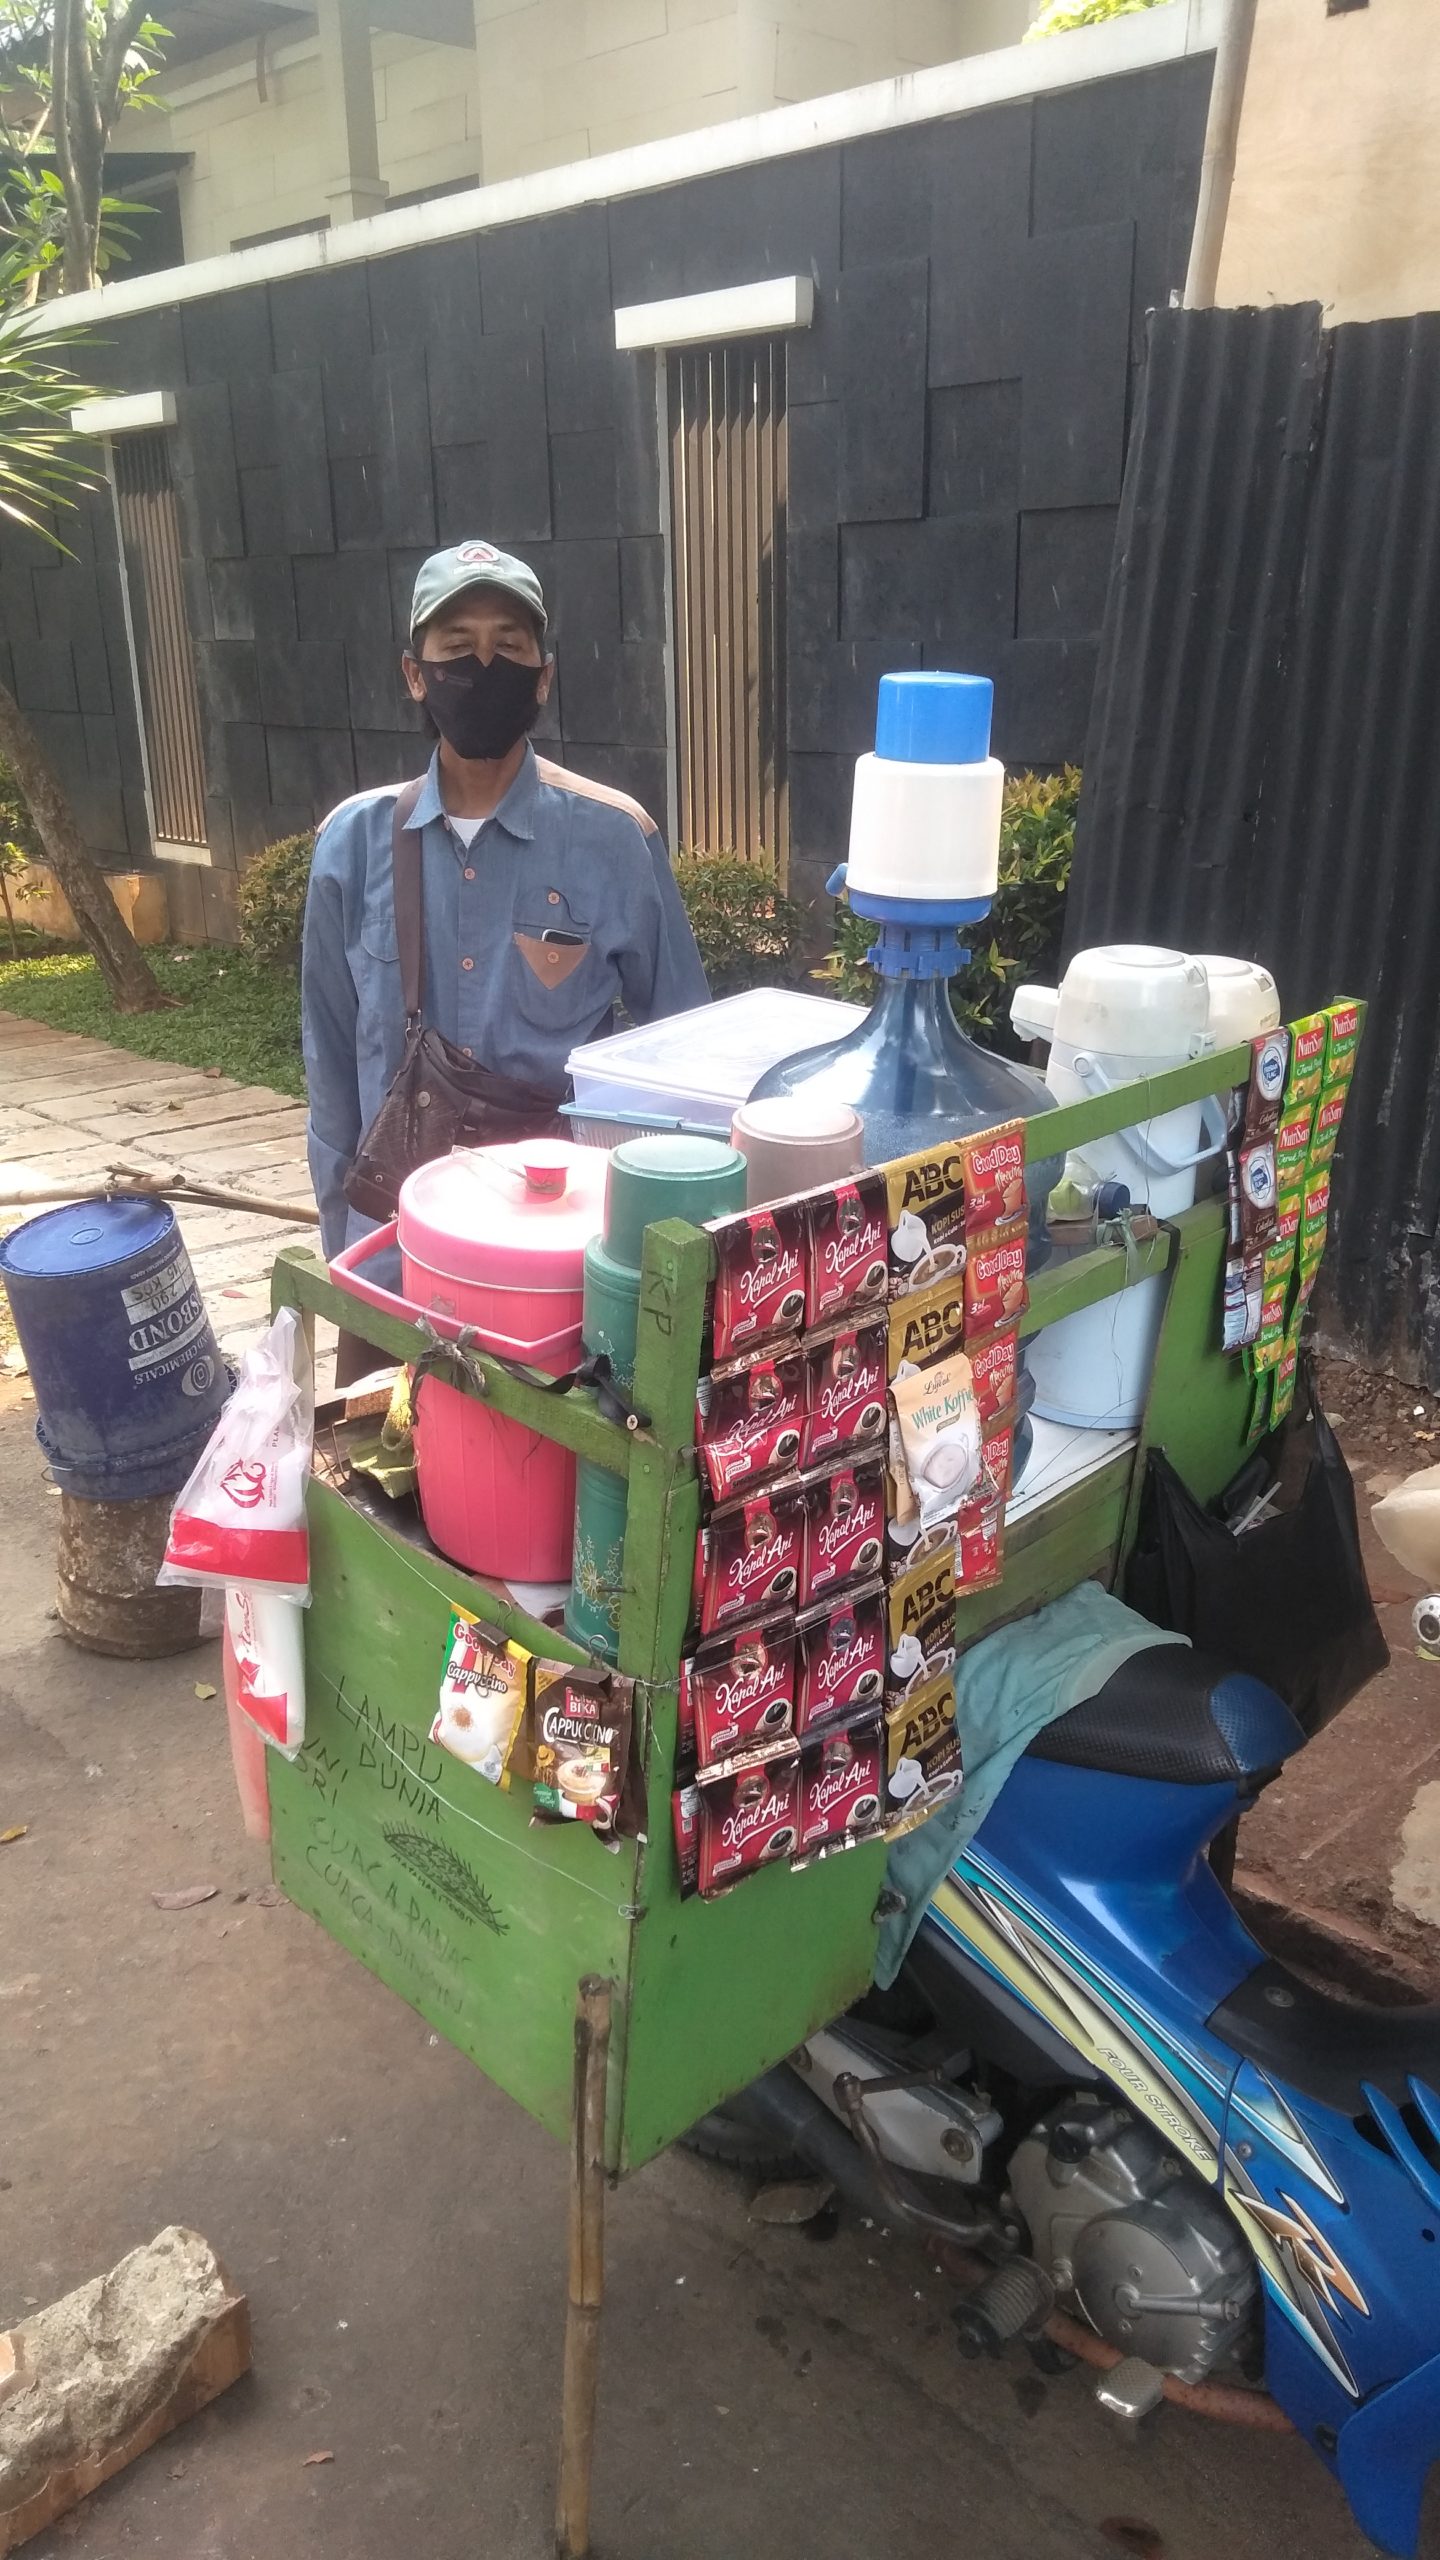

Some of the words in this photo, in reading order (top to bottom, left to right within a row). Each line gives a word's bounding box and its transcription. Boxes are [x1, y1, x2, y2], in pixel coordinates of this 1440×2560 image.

[902, 1156, 964, 1208] ABC
[973, 1148, 999, 1175] Good
[999, 1145, 1021, 1166] Day
[825, 1235, 860, 1274] Kapal
[859, 1221, 881, 1252] Api
[932, 1214, 950, 1235] KOPI
[740, 1264, 777, 1304] Kapal
[777, 1249, 799, 1282] Api
[976, 1253, 1000, 1279] Good
[1000, 1248, 1022, 1270] Day
[901, 1301, 962, 1358] ABC
[134, 1345, 198, 1385] CHEMICALS
[974, 1352, 995, 1379] Good
[994, 1342, 1014, 1367] Day
[771, 1394, 797, 1424] Api
[822, 1379, 855, 1418] Kapal
[854, 1366, 879, 1396] Api
[912, 1403, 941, 1431] White
[944, 1388, 973, 1415] Koffie
[989, 1438, 1009, 1462] Day
[819, 1516, 850, 1556] Kapal
[850, 1502, 875, 1532] Api
[729, 1549, 766, 1587] Kapal
[767, 1532, 794, 1563] Api
[901, 1569, 954, 1632] ABC
[447, 1661, 508, 1694] Cappuccino
[818, 1649, 849, 1690] Kapal
[849, 1634, 874, 1665] Api
[570, 1702, 596, 1714] BIKA
[716, 1677, 760, 1714] Kapal
[759, 1663, 786, 1692] Api
[336, 1675, 443, 1784] LAMPU
[543, 1706, 614, 1744] CAPPUCCINO
[900, 1692, 956, 1755] ABC
[359, 1742, 448, 1824] DUNIA
[809, 1774, 843, 1812] Kapal
[845, 1760, 871, 1790] Api
[722, 1807, 760, 1847] Kapal
[760, 1793, 790, 1823] Api
[1097, 2047, 1148, 2092] FOUR
[1144, 2094, 1215, 2161] STROKE
